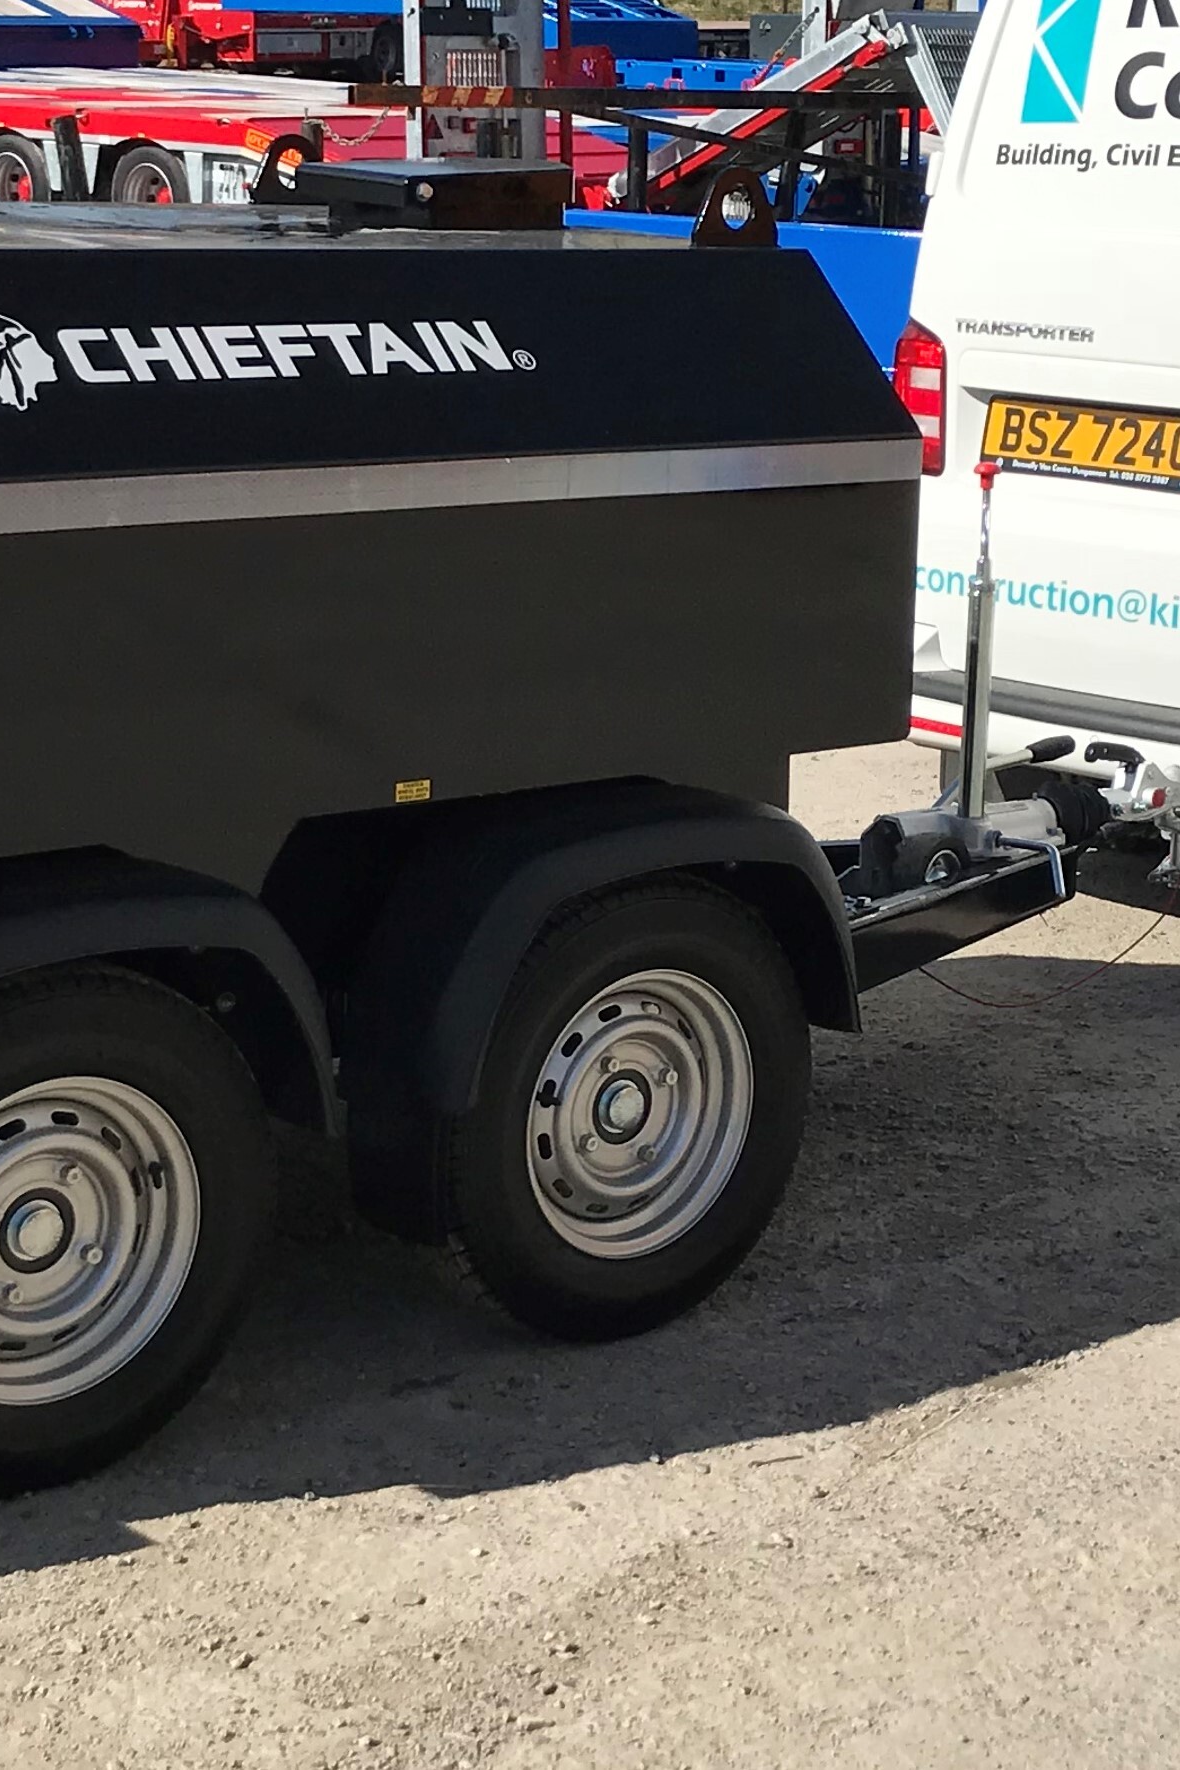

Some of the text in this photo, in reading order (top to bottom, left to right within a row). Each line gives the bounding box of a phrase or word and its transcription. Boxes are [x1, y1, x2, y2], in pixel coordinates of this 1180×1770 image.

[996, 143, 1098, 172] Building,
[1106, 143, 1161, 167] Civil
[955, 318, 1095, 343] TRANSPORTER
[999, 407, 1079, 458] BSZ
[915, 565, 1180, 629] conruction@ki
